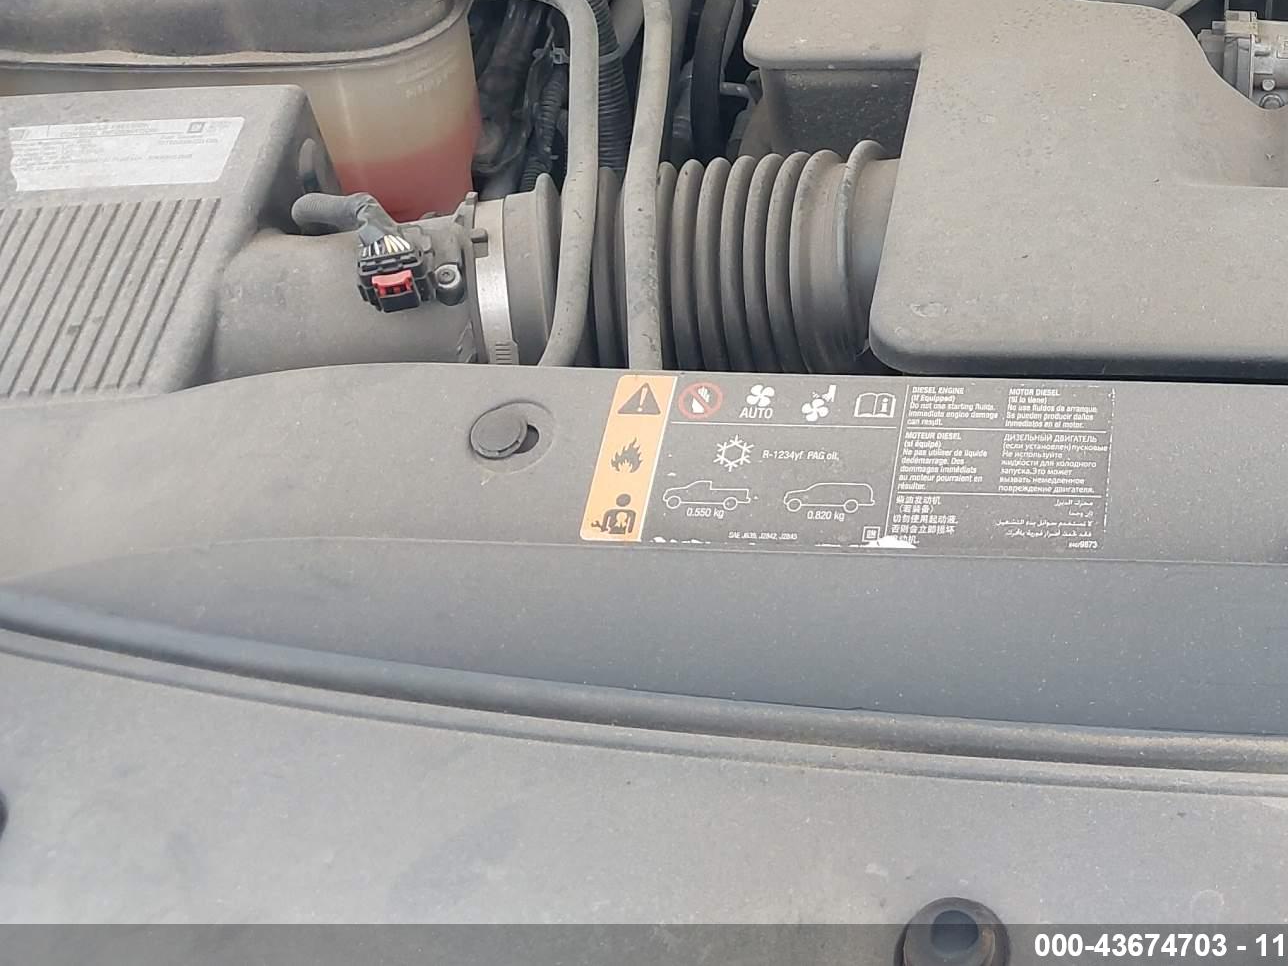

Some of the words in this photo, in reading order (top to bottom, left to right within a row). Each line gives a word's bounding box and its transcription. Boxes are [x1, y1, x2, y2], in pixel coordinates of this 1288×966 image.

[1009, 388, 1034, 396] MOTOR
[947, 403, 973, 411] starting
[1032, 404, 1055, 412] fluidos
[739, 407, 773, 419] AUTO
[946, 411, 969, 419] engine
[1017, 412, 1042, 420] pueden
[1043, 413, 1072, 421] producir
[936, 432, 962, 440] DIESEL
[1003, 433, 1053, 442] ДИЗЕЛЬНЫЙ
[1053, 435, 1098, 443] ДВИГАТЕЛЬ
[1002, 442, 1024, 450] (если
[762, 449, 804, 461] R-1234yf
[807, 450, 824, 460] PAG
[953, 449, 963, 457] de
[964, 450, 988, 458] liquide
[900, 466, 939, 474] dommages
[936, 475, 972, 483] pourraient
[687, 507, 712, 517] 0.550
[713, 508, 725, 519] kg
[807, 510, 832, 520] 0.820
[833, 511, 845, 522] kg
